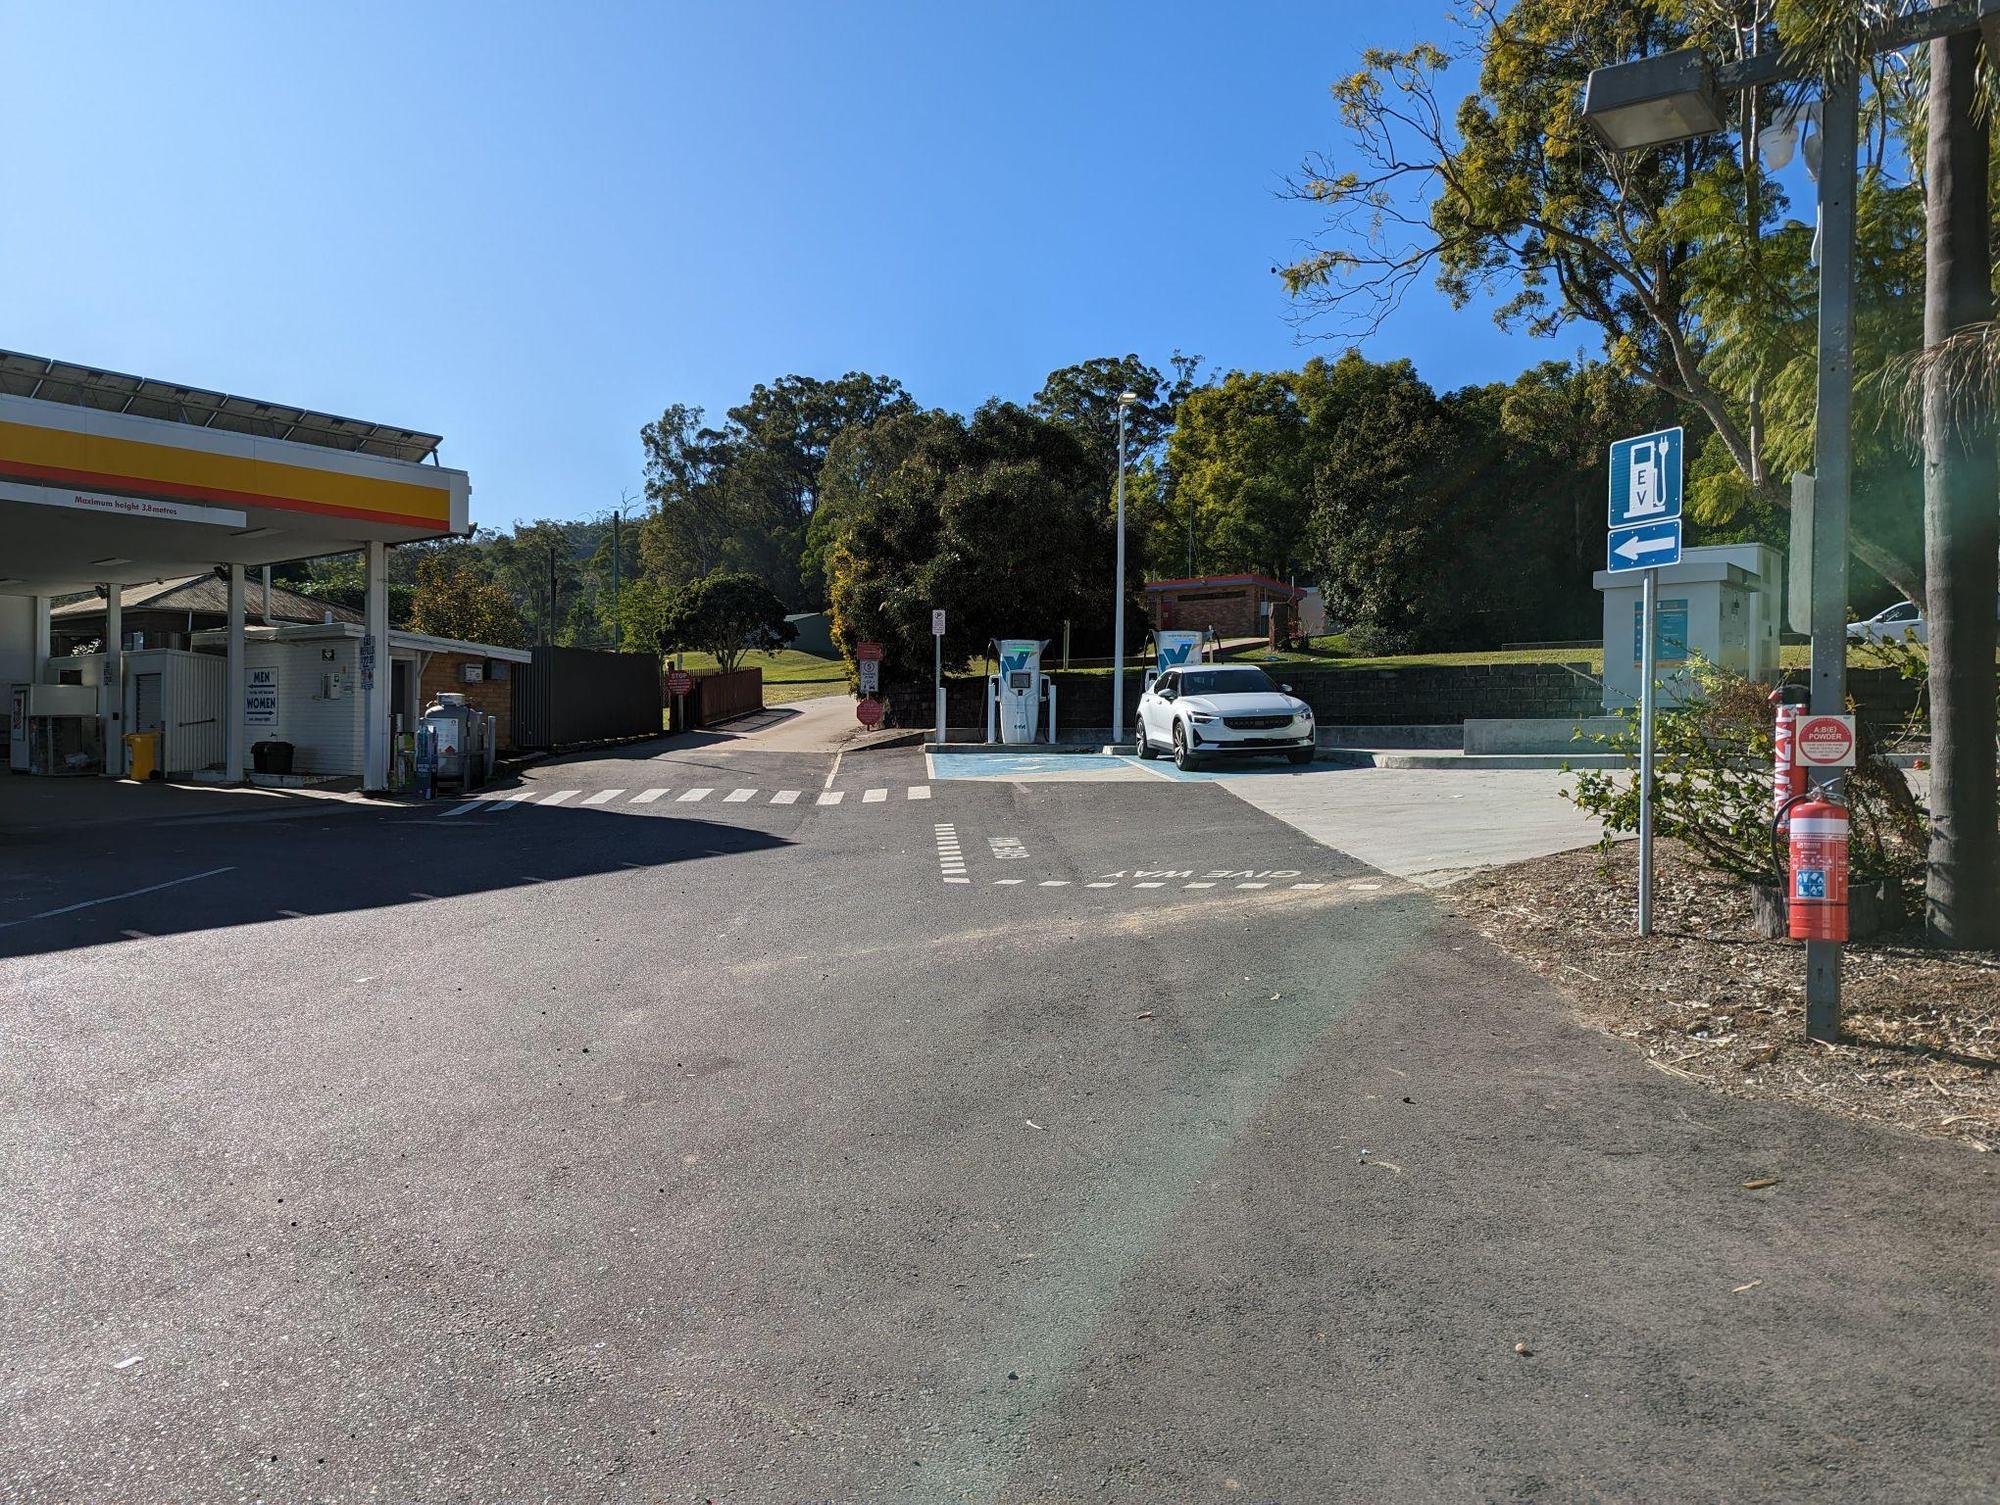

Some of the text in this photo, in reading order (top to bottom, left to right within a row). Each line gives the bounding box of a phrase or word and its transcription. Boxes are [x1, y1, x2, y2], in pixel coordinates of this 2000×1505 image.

[74, 495, 113, 508] Maximum
[115, 500, 139, 511] height
[254, 671, 270, 683] MEN
[671, 672, 688, 680] STOP
[247, 697, 276, 709] WOMEN
[1099, 870, 1302, 878] GIVE WAY
